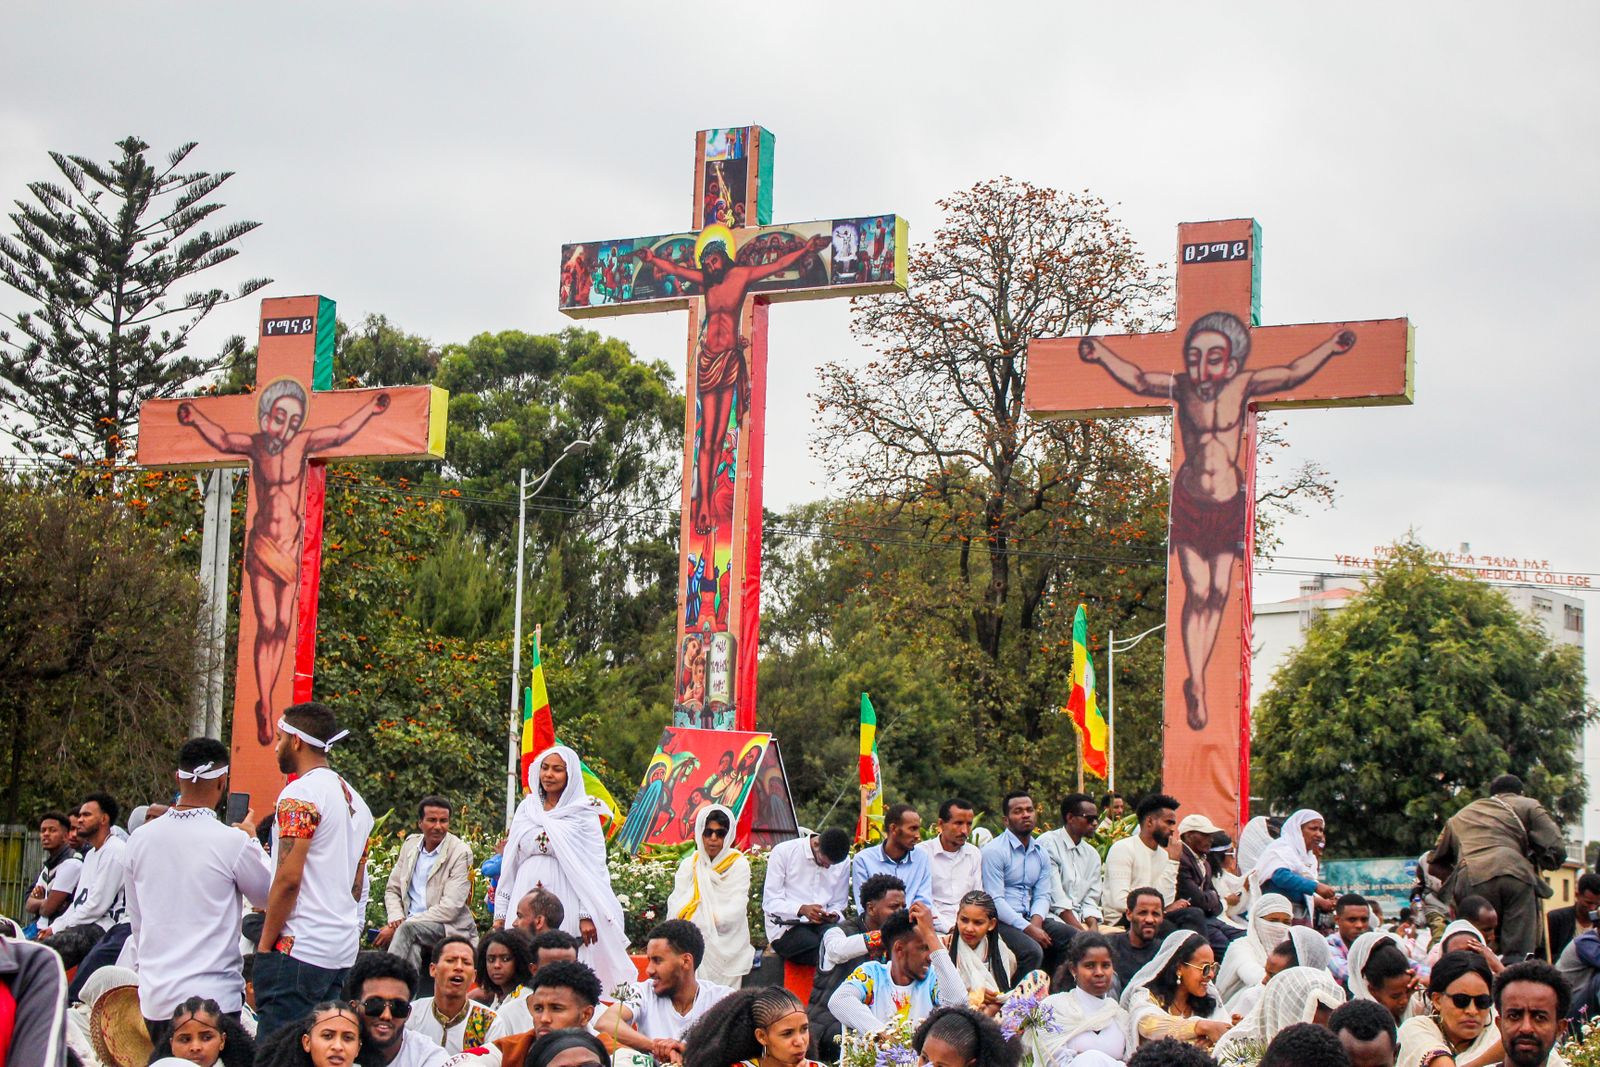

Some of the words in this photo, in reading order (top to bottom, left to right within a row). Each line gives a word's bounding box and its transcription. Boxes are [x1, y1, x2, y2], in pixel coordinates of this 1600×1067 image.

[1185, 242, 1245, 261] ፀጋማይ
[267, 318, 312, 335] የማናይ
[1335, 554, 1391, 570] YEKAT
[1479, 568, 1530, 582] MEDICAL
[1535, 573, 1590, 587] COLLEGE
